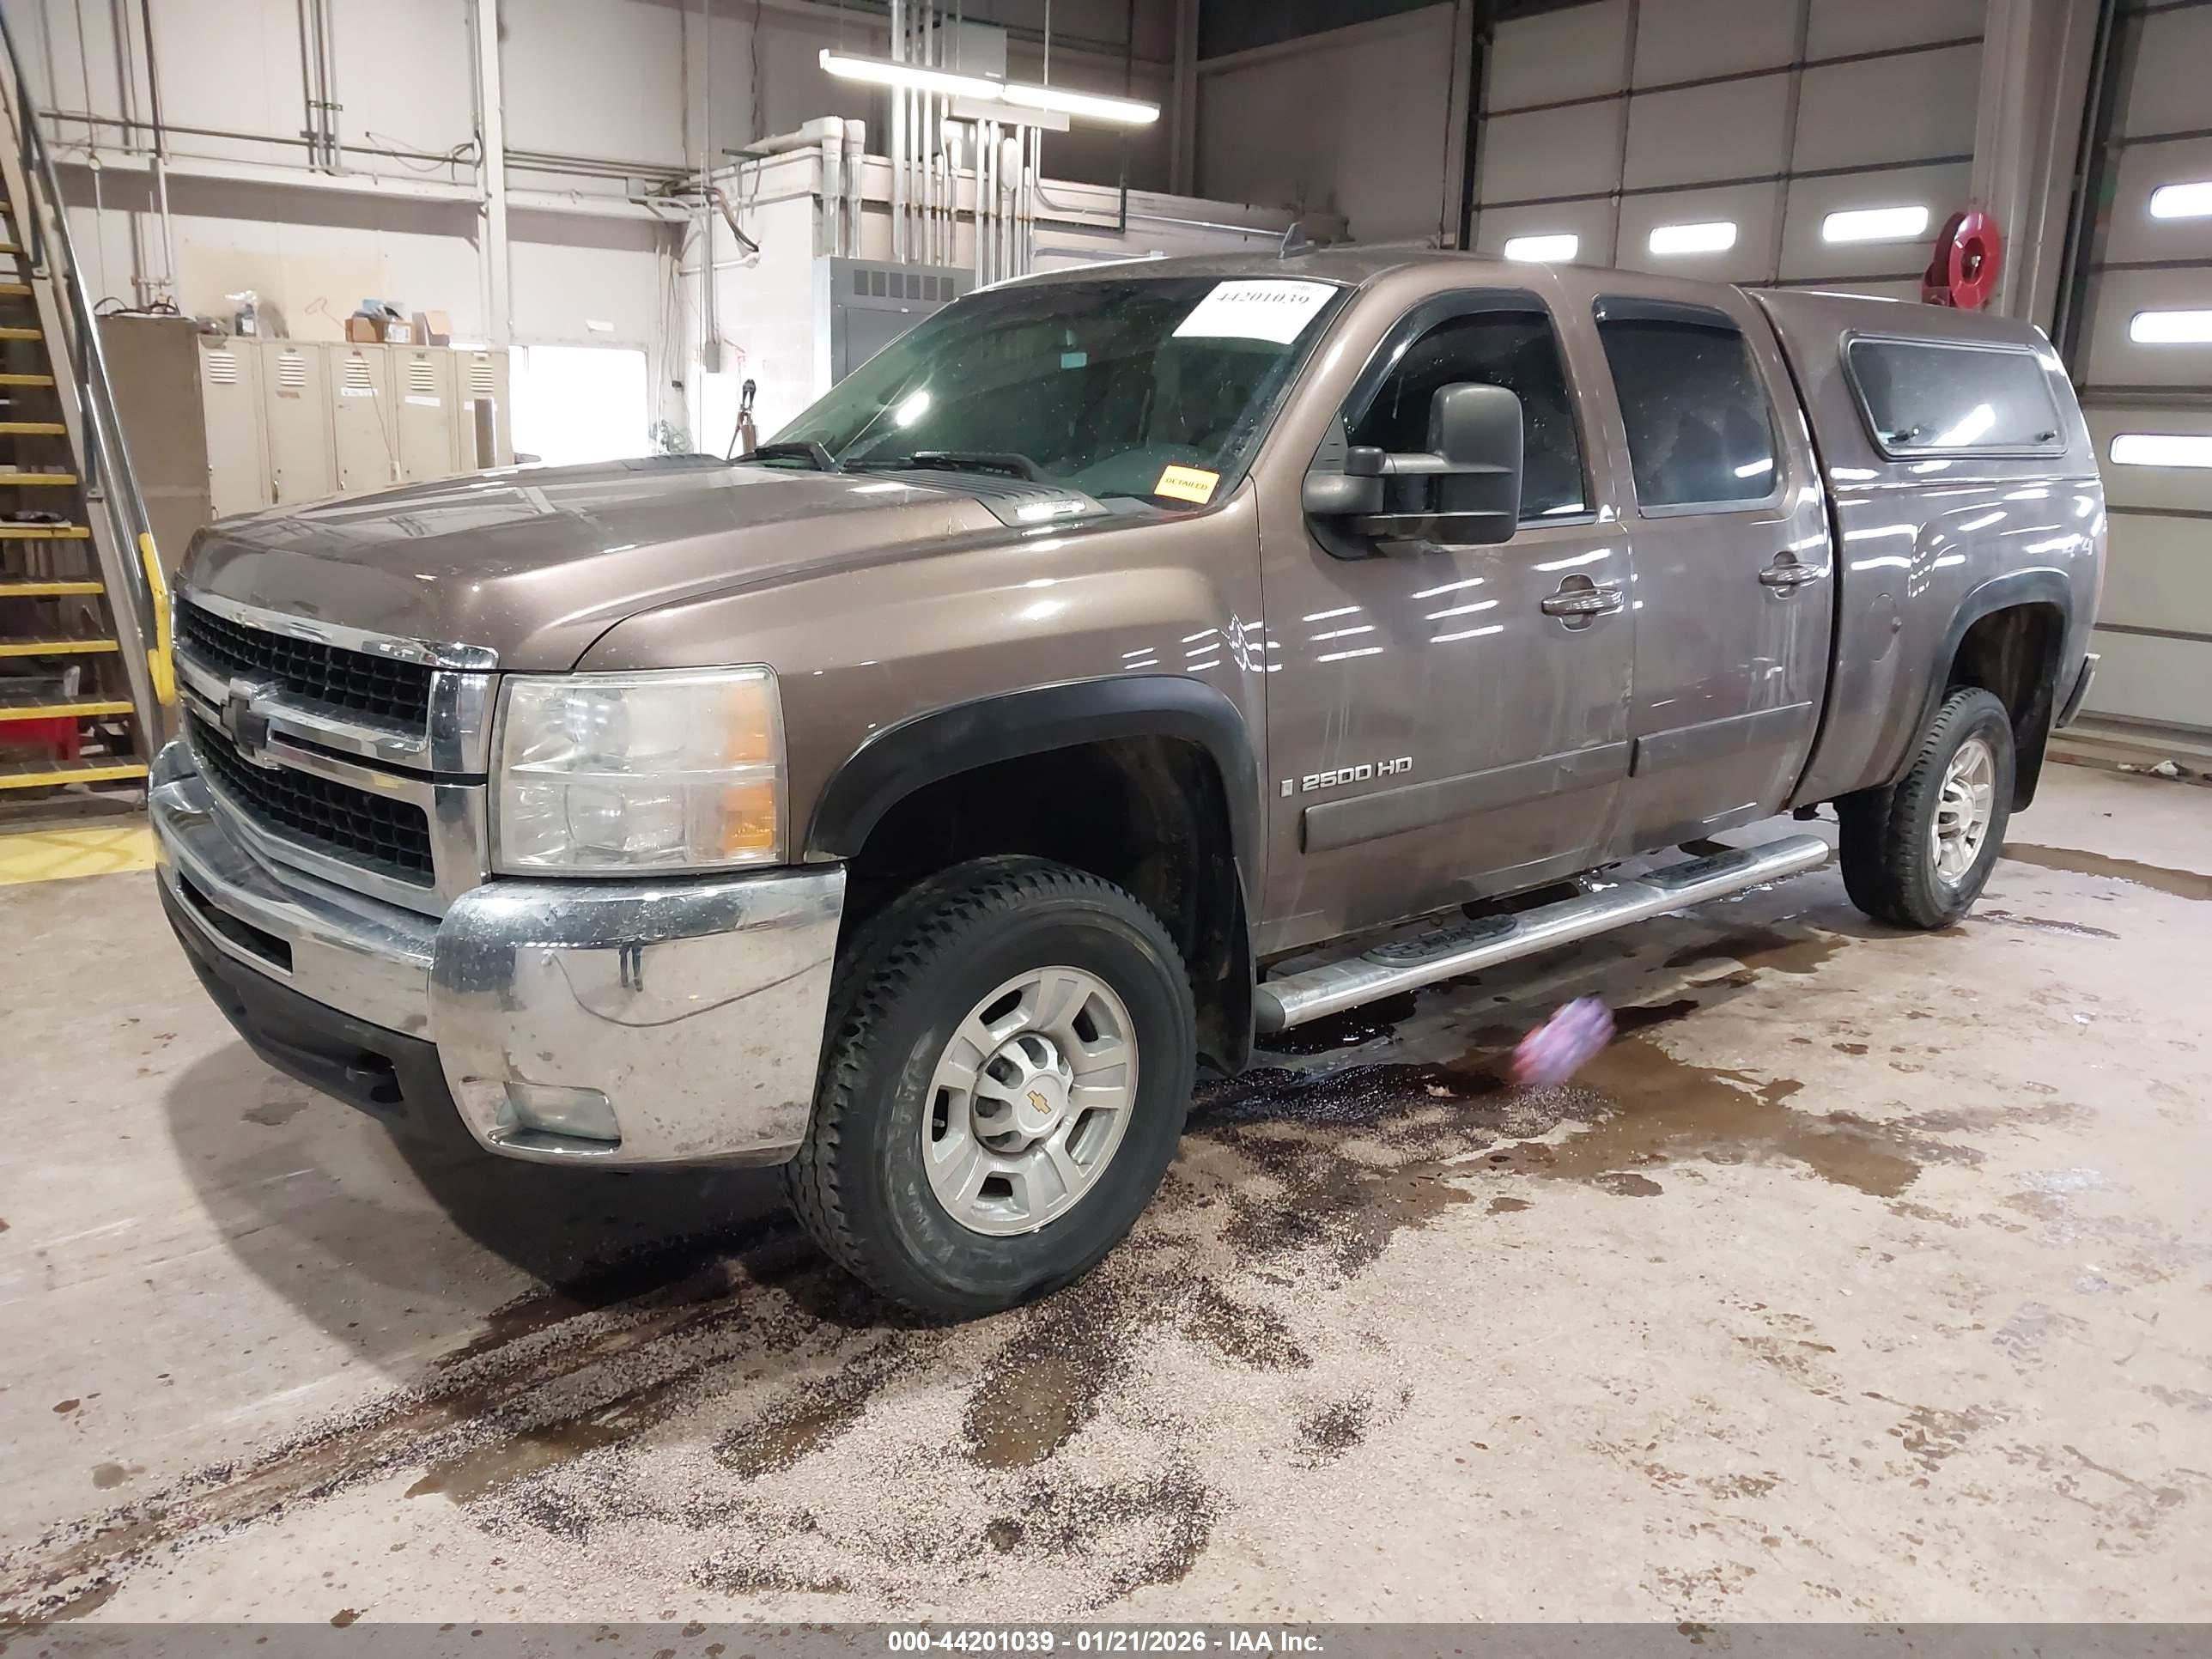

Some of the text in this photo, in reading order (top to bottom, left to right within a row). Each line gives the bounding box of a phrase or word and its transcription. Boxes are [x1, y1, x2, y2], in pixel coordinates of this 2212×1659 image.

[1217, 292, 1310, 305] 44201039
[1165, 477, 1208, 490] DETAILED
[2063, 537, 2094, 557] 44
[1302, 757, 1413, 793] 2500 HD
